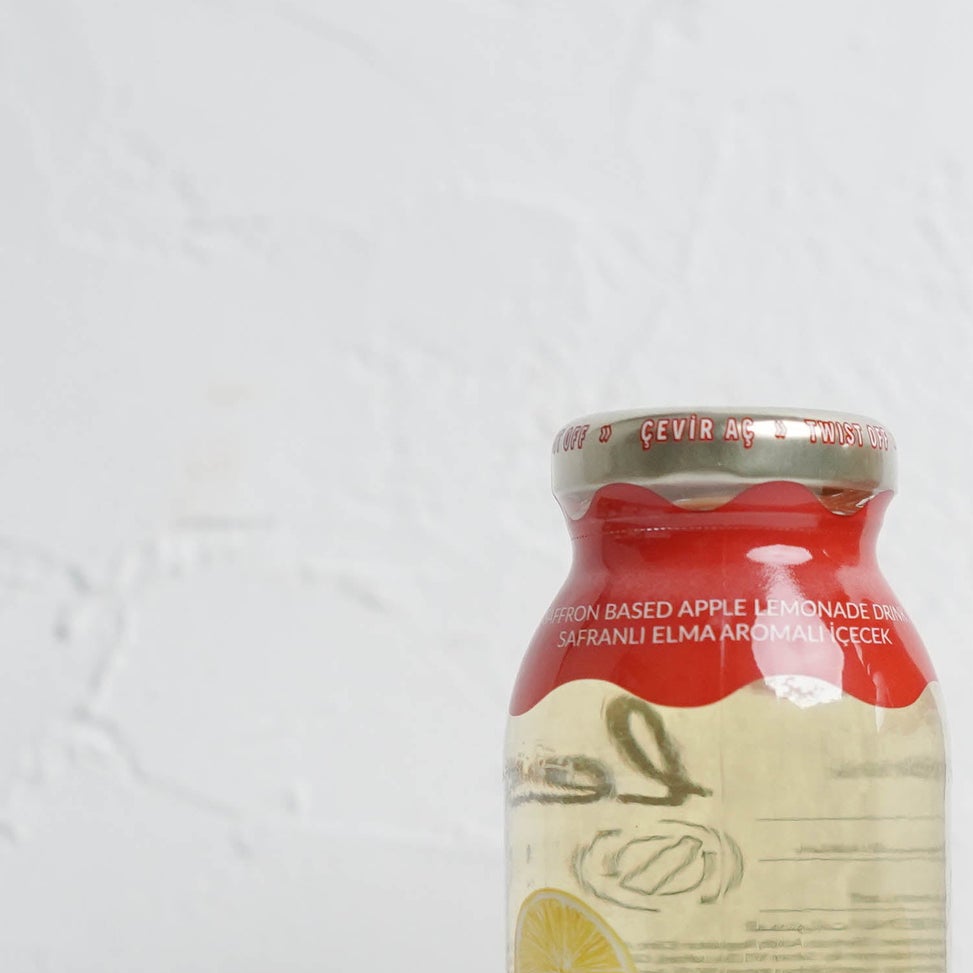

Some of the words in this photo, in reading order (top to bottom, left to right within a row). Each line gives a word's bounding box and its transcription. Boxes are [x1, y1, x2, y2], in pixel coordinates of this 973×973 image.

[562, 424, 591, 452] OFF
[640, 412, 714, 451] ÇEVİR
[722, 416, 755, 450] AÇ
[803, 418, 864, 448] TWIST
[604, 601, 673, 621] BASED
[677, 598, 747, 618] APPLE
[754, 598, 870, 621] LEMONADE
[556, 626, 646, 649] SAFRANLI
[652, 624, 716, 645] ELMA
[720, 623, 824, 644] AROMALI
[829, 621, 893, 647] İÇECEK
